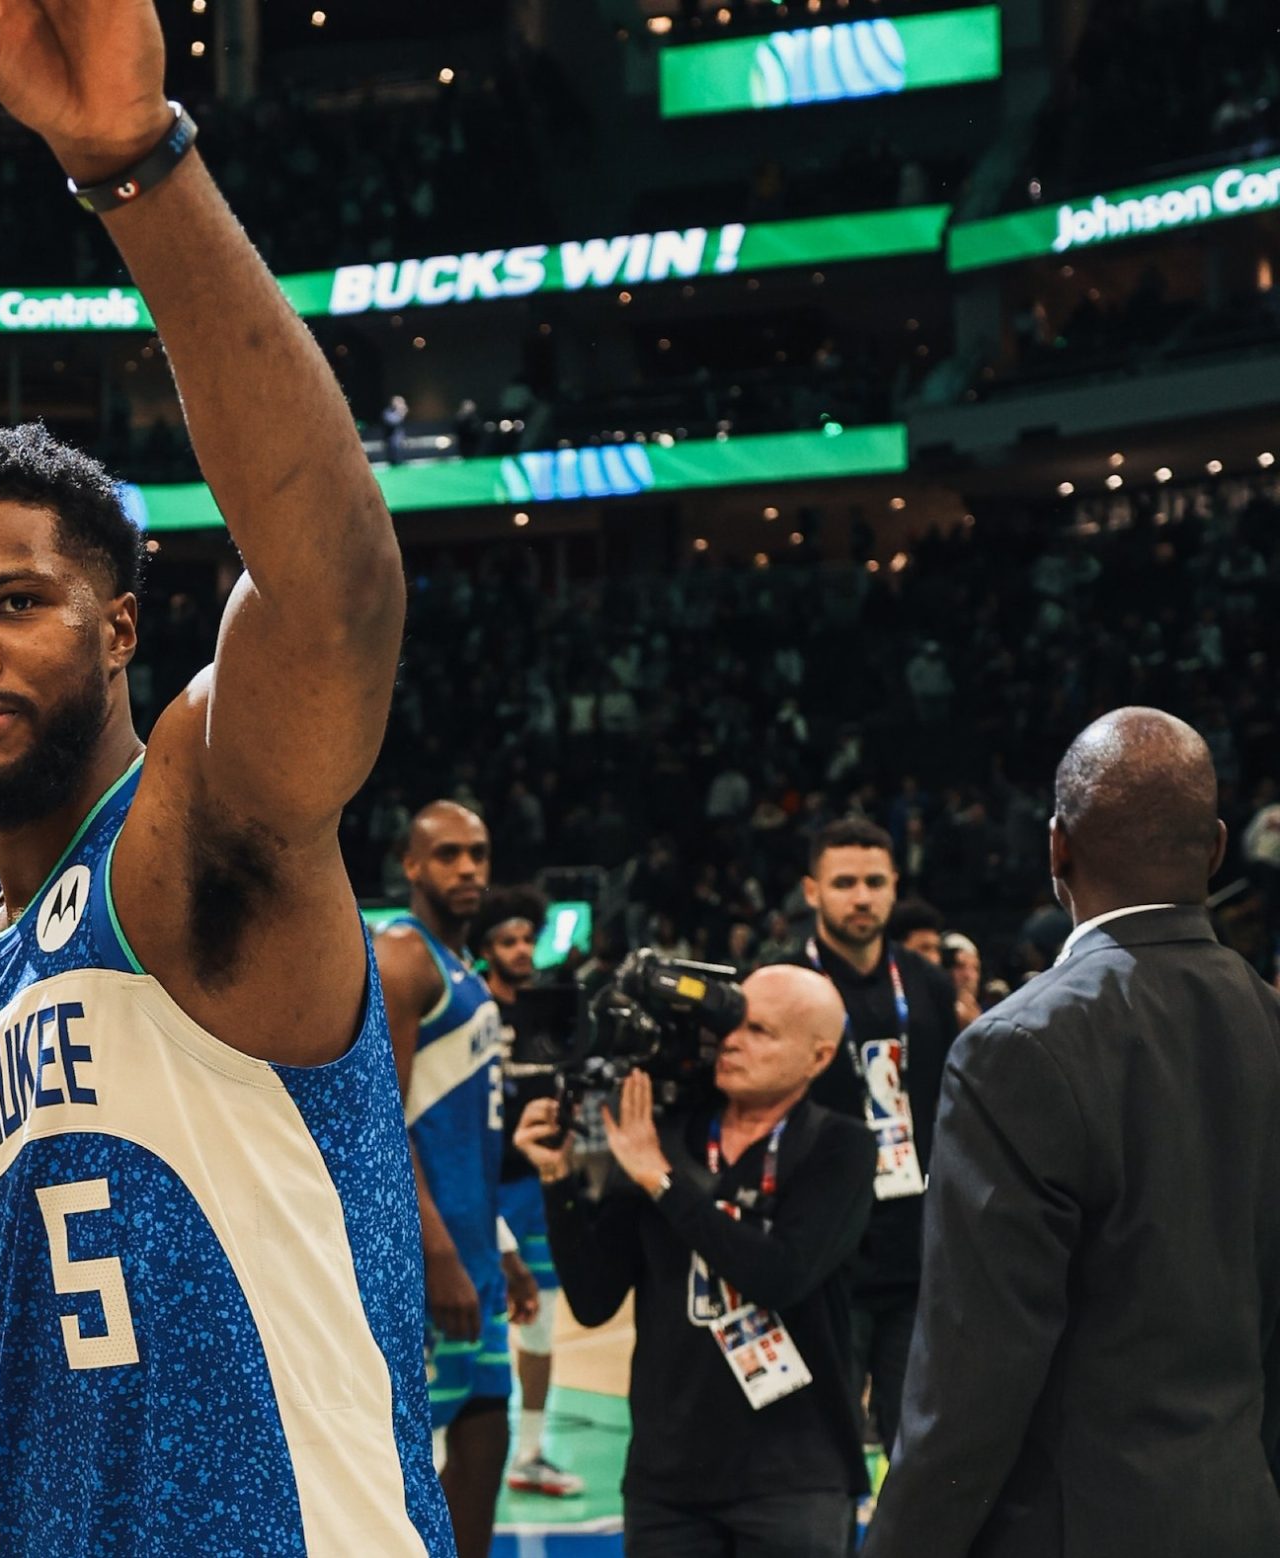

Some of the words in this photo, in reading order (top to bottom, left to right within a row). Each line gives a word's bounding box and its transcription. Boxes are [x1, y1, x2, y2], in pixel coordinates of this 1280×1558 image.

[1052, 195, 1212, 253] Johnson
[329, 244, 549, 316] BUCKS
[34, 1177, 140, 1370] 5
